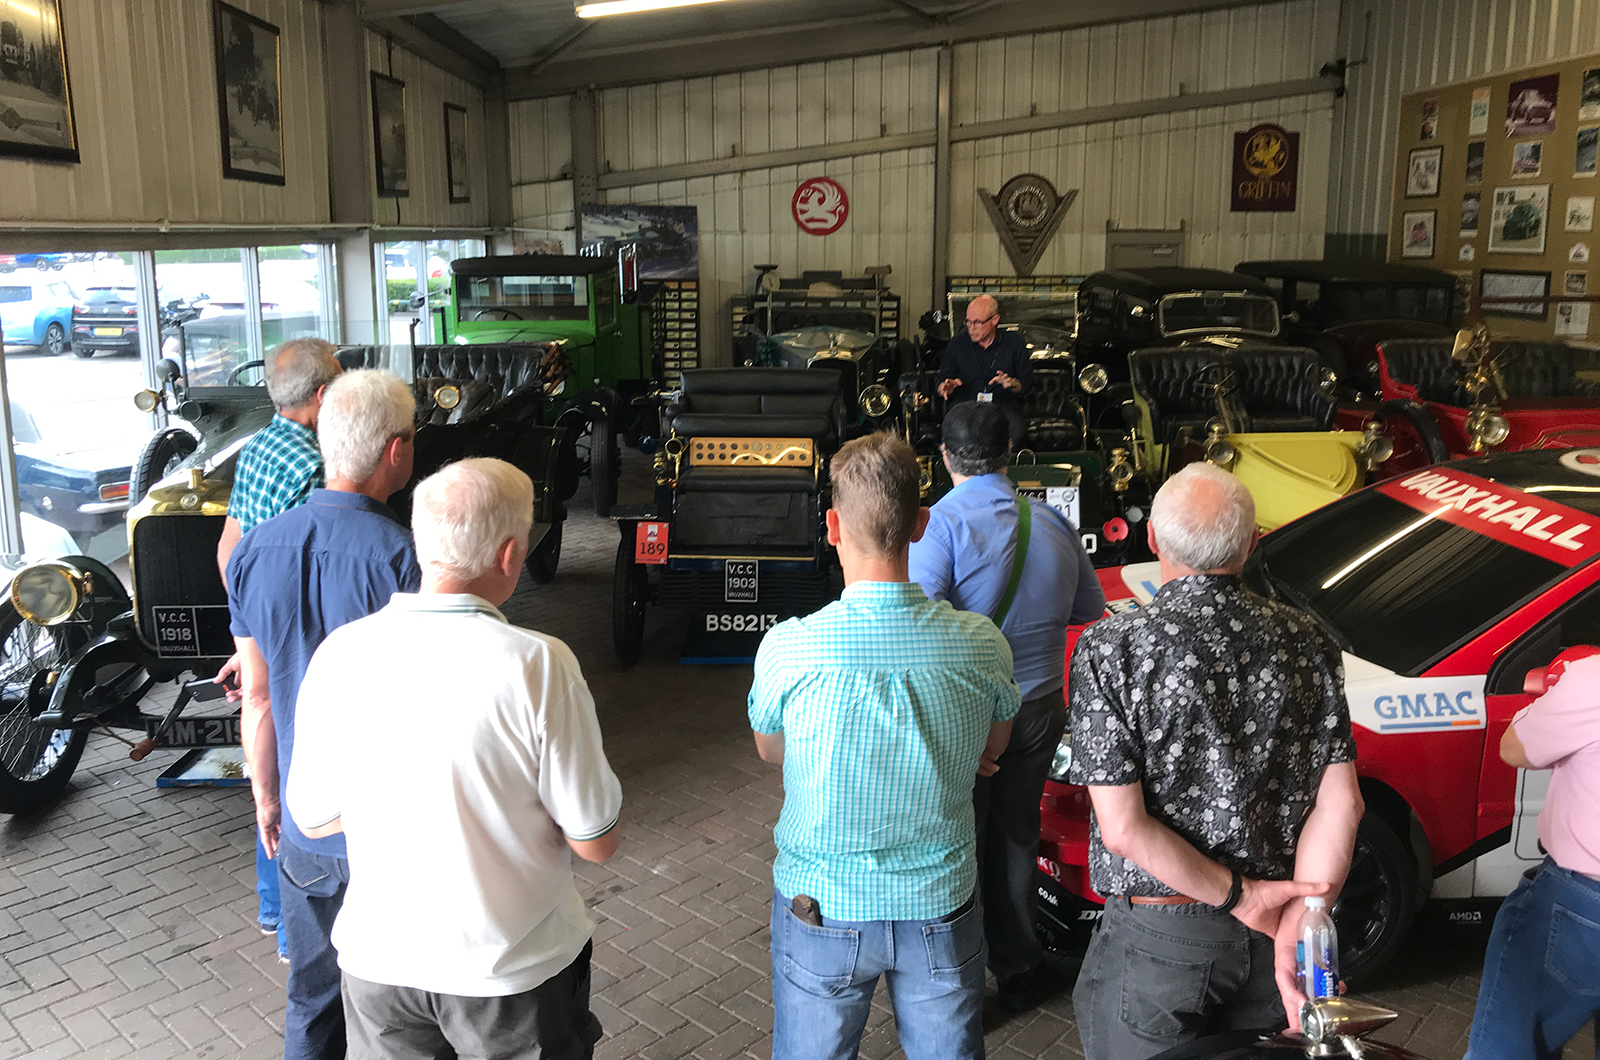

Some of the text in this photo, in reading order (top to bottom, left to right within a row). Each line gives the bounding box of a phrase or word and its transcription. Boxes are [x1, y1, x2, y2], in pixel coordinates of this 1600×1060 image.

[1238, 180, 1291, 199] GRIFFIN
[1400, 470, 1591, 551] VAUXHALL
[640, 542, 665, 555] 189
[728, 577, 756, 589] 1903
[158, 612, 190, 622] V.C.C.
[706, 614, 778, 632] BS8213
[160, 627, 192, 641] 1918
[1373, 690, 1478, 719] GMAC
[1449, 911, 1473, 920] AMD
